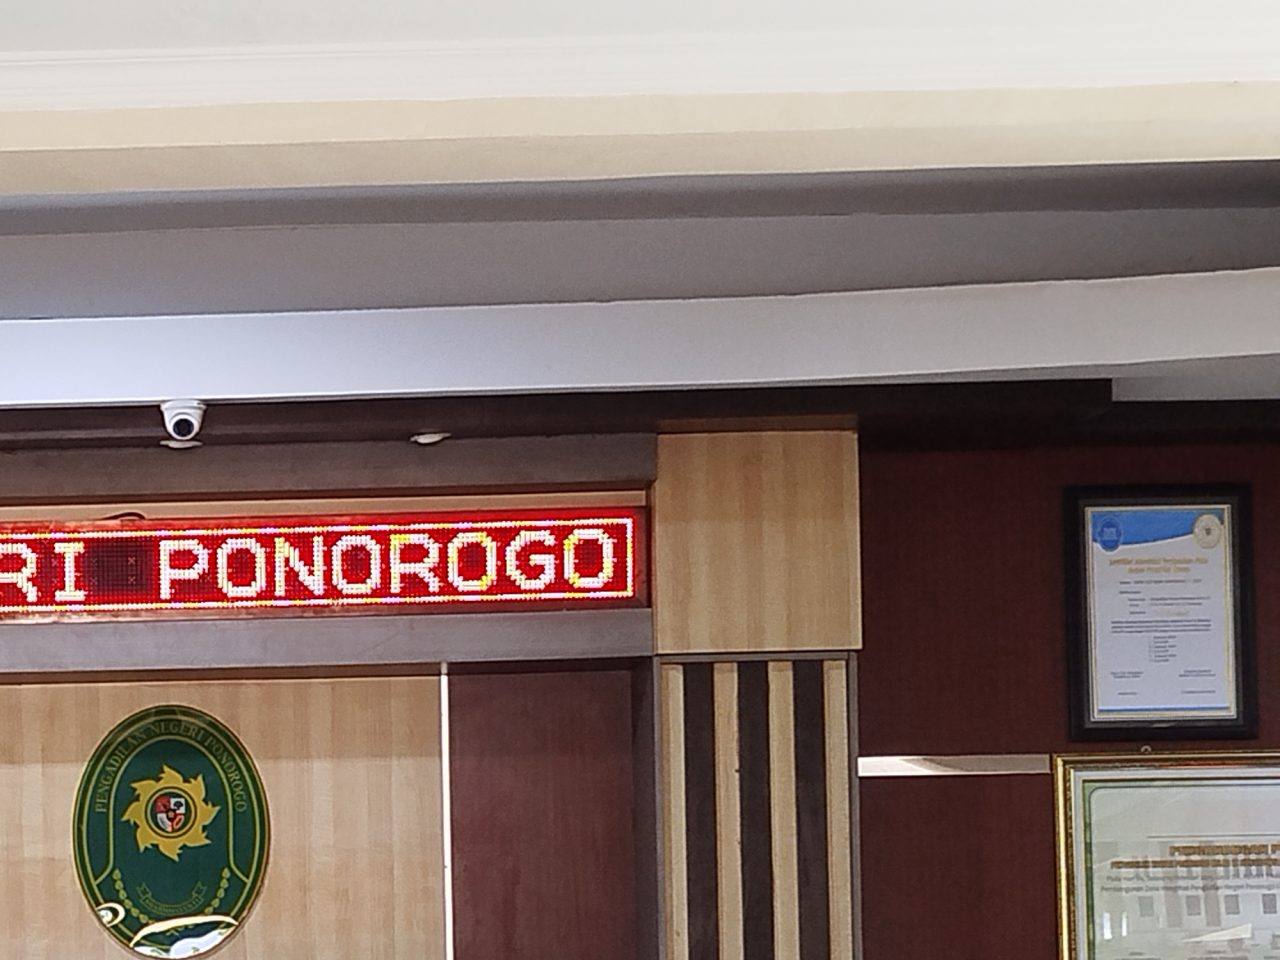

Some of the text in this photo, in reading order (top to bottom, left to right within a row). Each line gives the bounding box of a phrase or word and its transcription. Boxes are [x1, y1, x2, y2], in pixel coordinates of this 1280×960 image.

[158, 527, 614, 600] PONOROGO
[94, 719, 248, 813] PENGADILAN NEGERI PONOROGO
